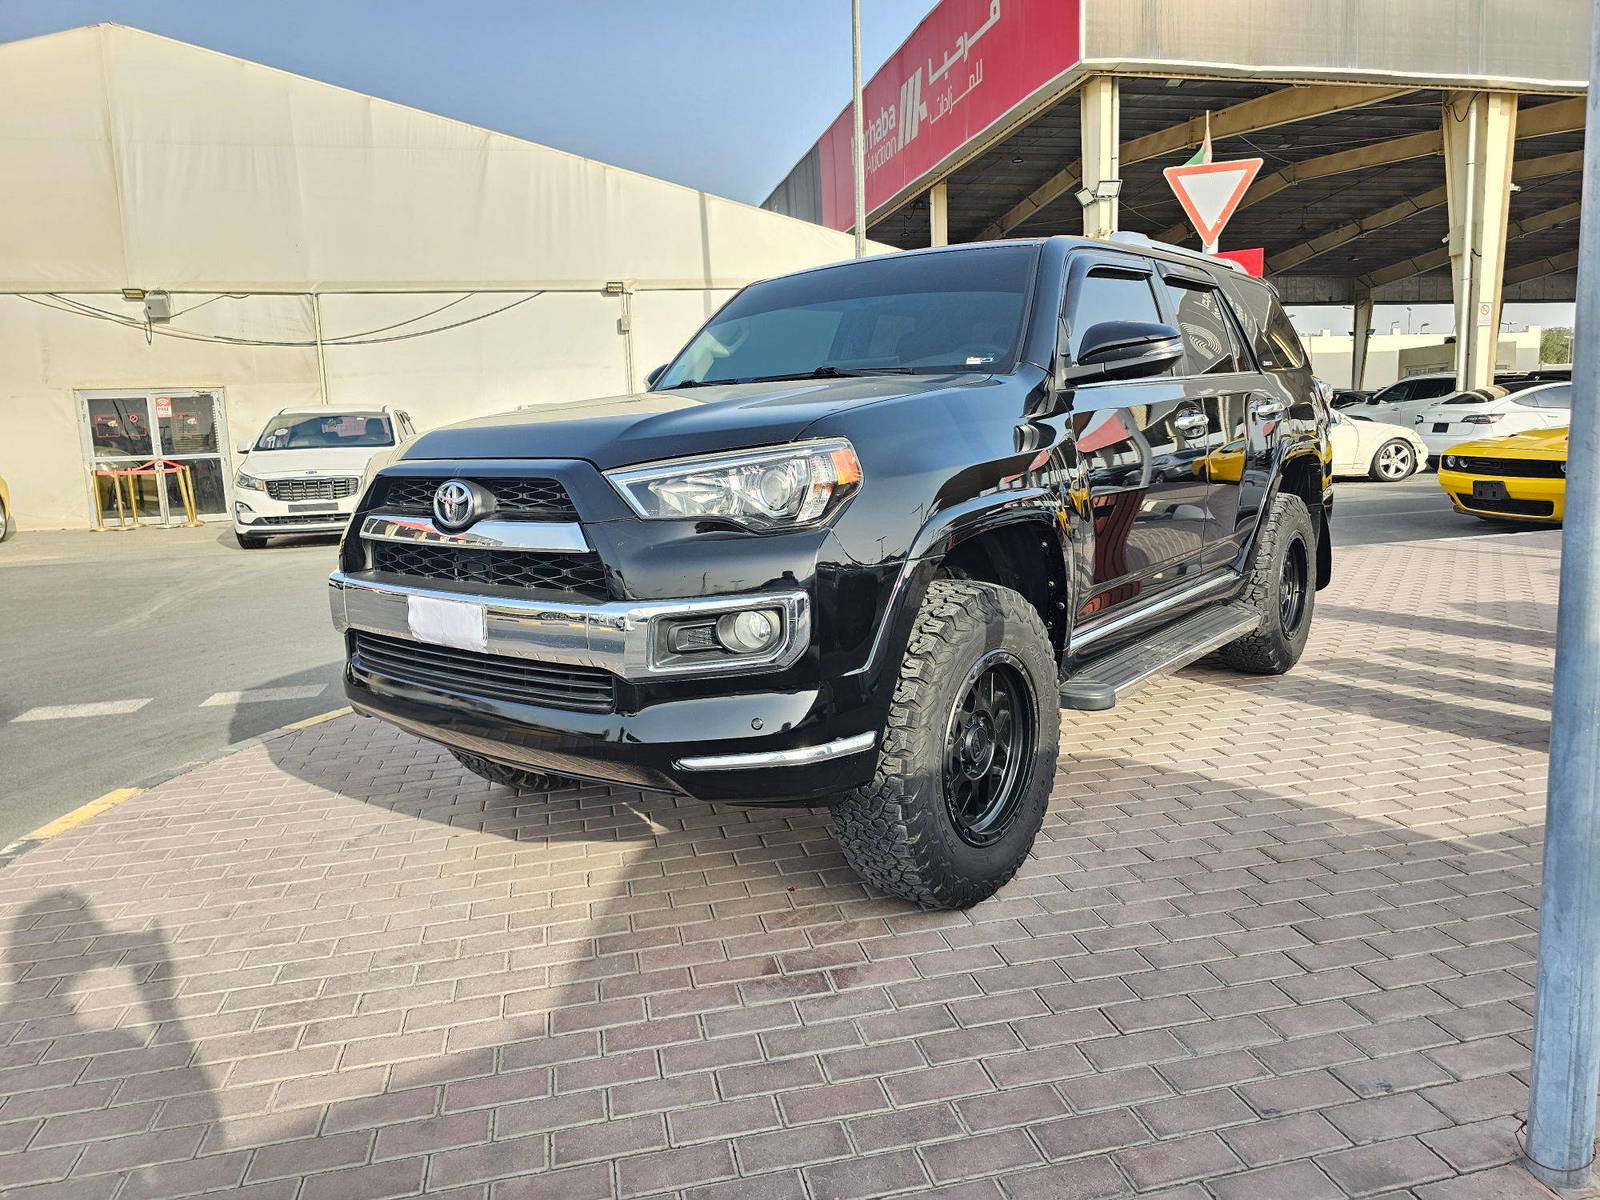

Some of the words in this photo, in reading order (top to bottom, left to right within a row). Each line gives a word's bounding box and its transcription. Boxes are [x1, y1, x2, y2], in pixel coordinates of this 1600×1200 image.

[928, 0, 1001, 86] مرحبا
[851, 104, 896, 166] rhaba
[865, 136, 897, 178] Auction
